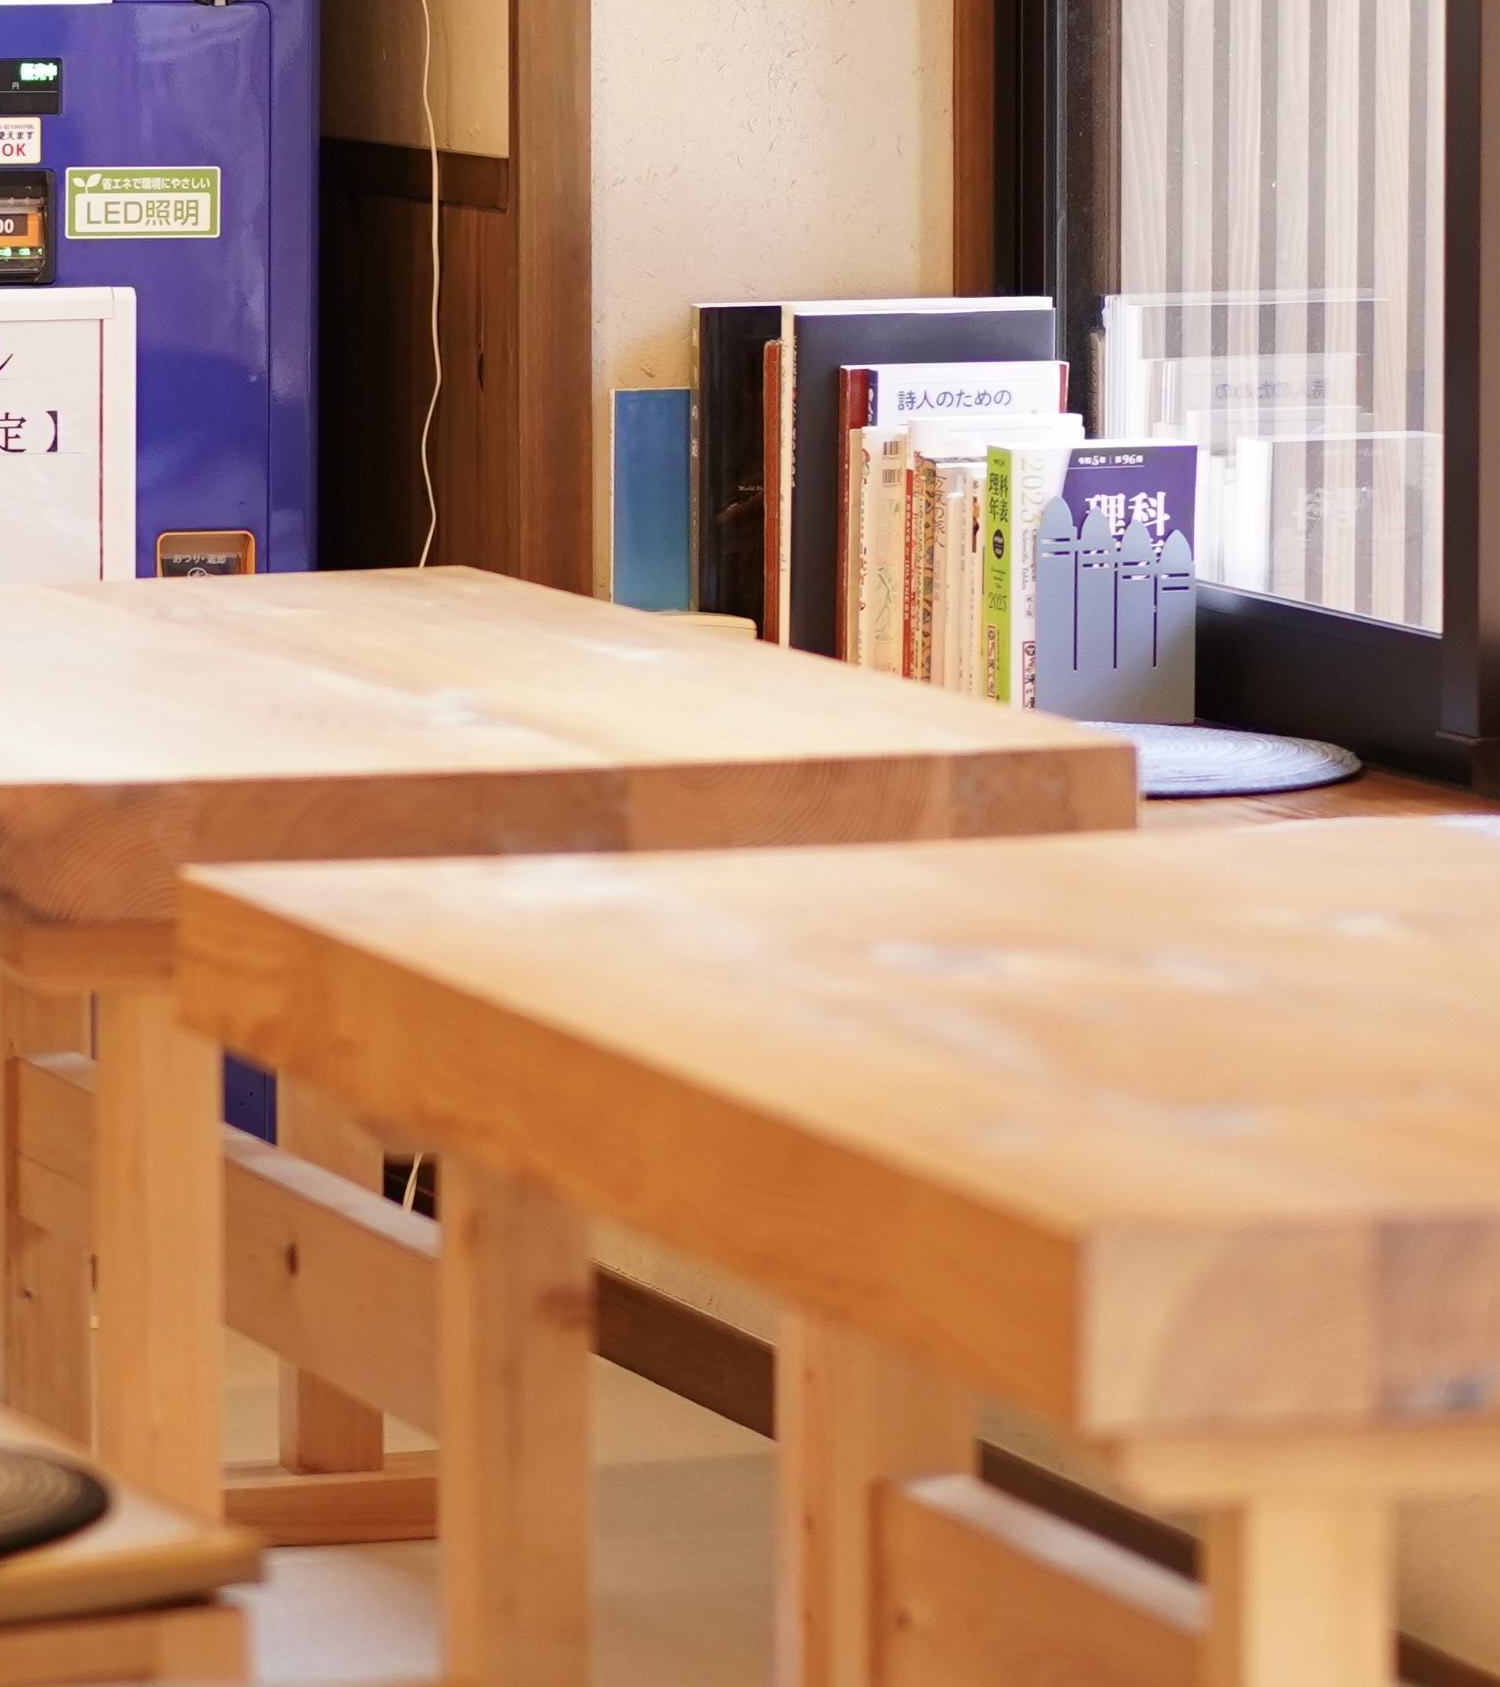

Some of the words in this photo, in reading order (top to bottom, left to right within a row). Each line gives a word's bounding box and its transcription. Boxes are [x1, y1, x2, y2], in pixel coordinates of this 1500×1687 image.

[3, 143, 26, 156] OK
[102, 177, 210, 190] 省エネで環境にやさしい
[86, 199, 199, 227] LED照明
[896, 388, 1013, 411] 詩人のための
[1084, 491, 1171, 538] 理科
